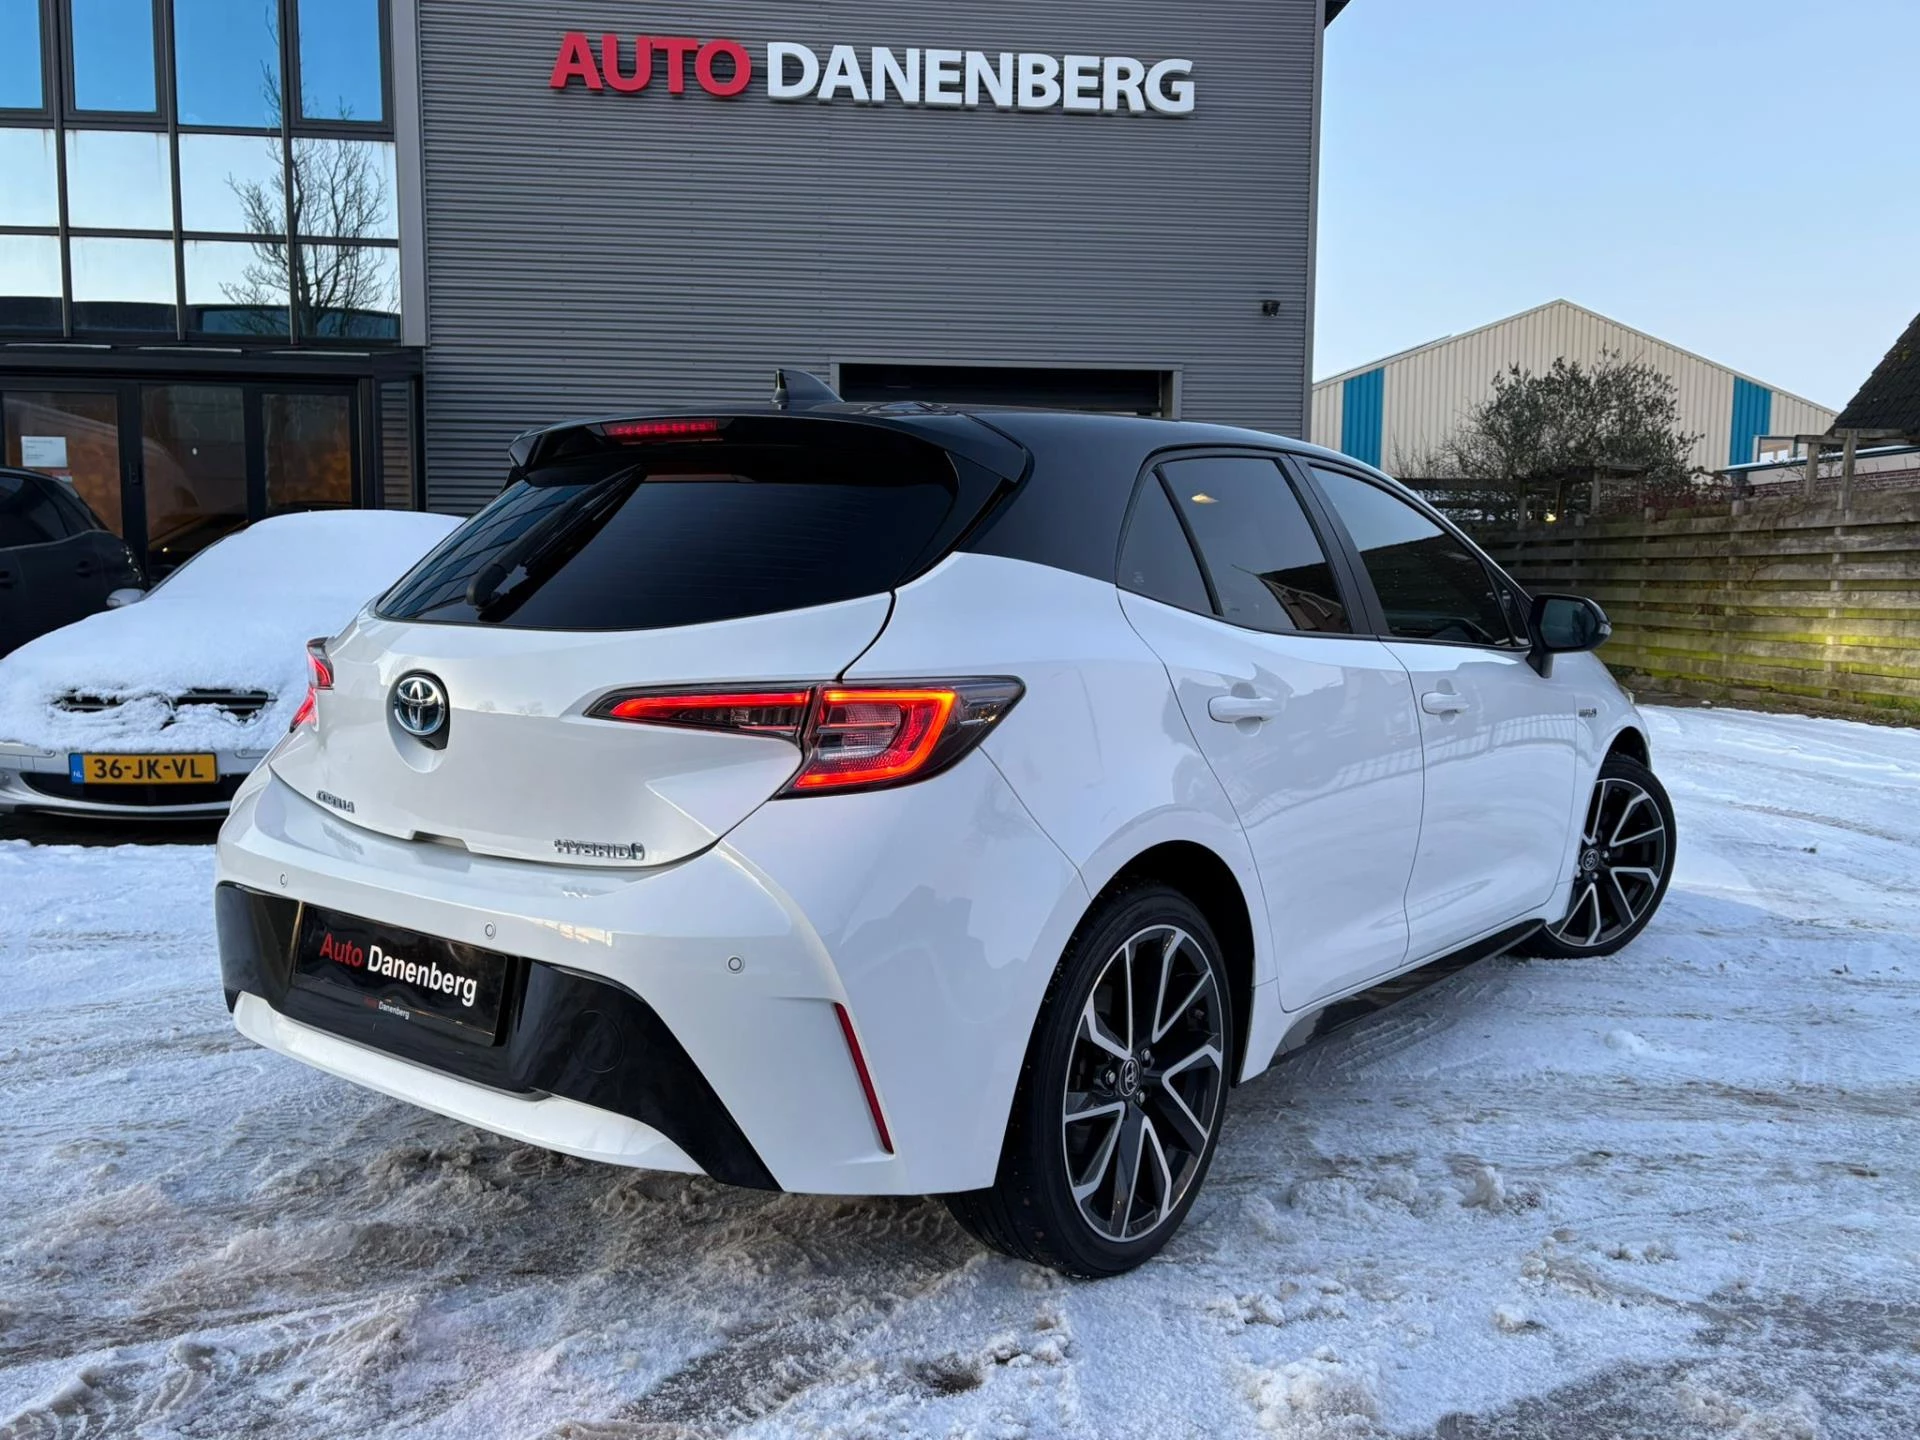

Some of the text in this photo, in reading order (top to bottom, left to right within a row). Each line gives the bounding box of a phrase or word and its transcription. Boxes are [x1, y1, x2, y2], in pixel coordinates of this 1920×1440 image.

[549, 31, 1195, 117] AUTO DANENBERG
[93, 758, 204, 780] 36-JK-VL
[319, 932, 478, 1008] Auto Danenberg
